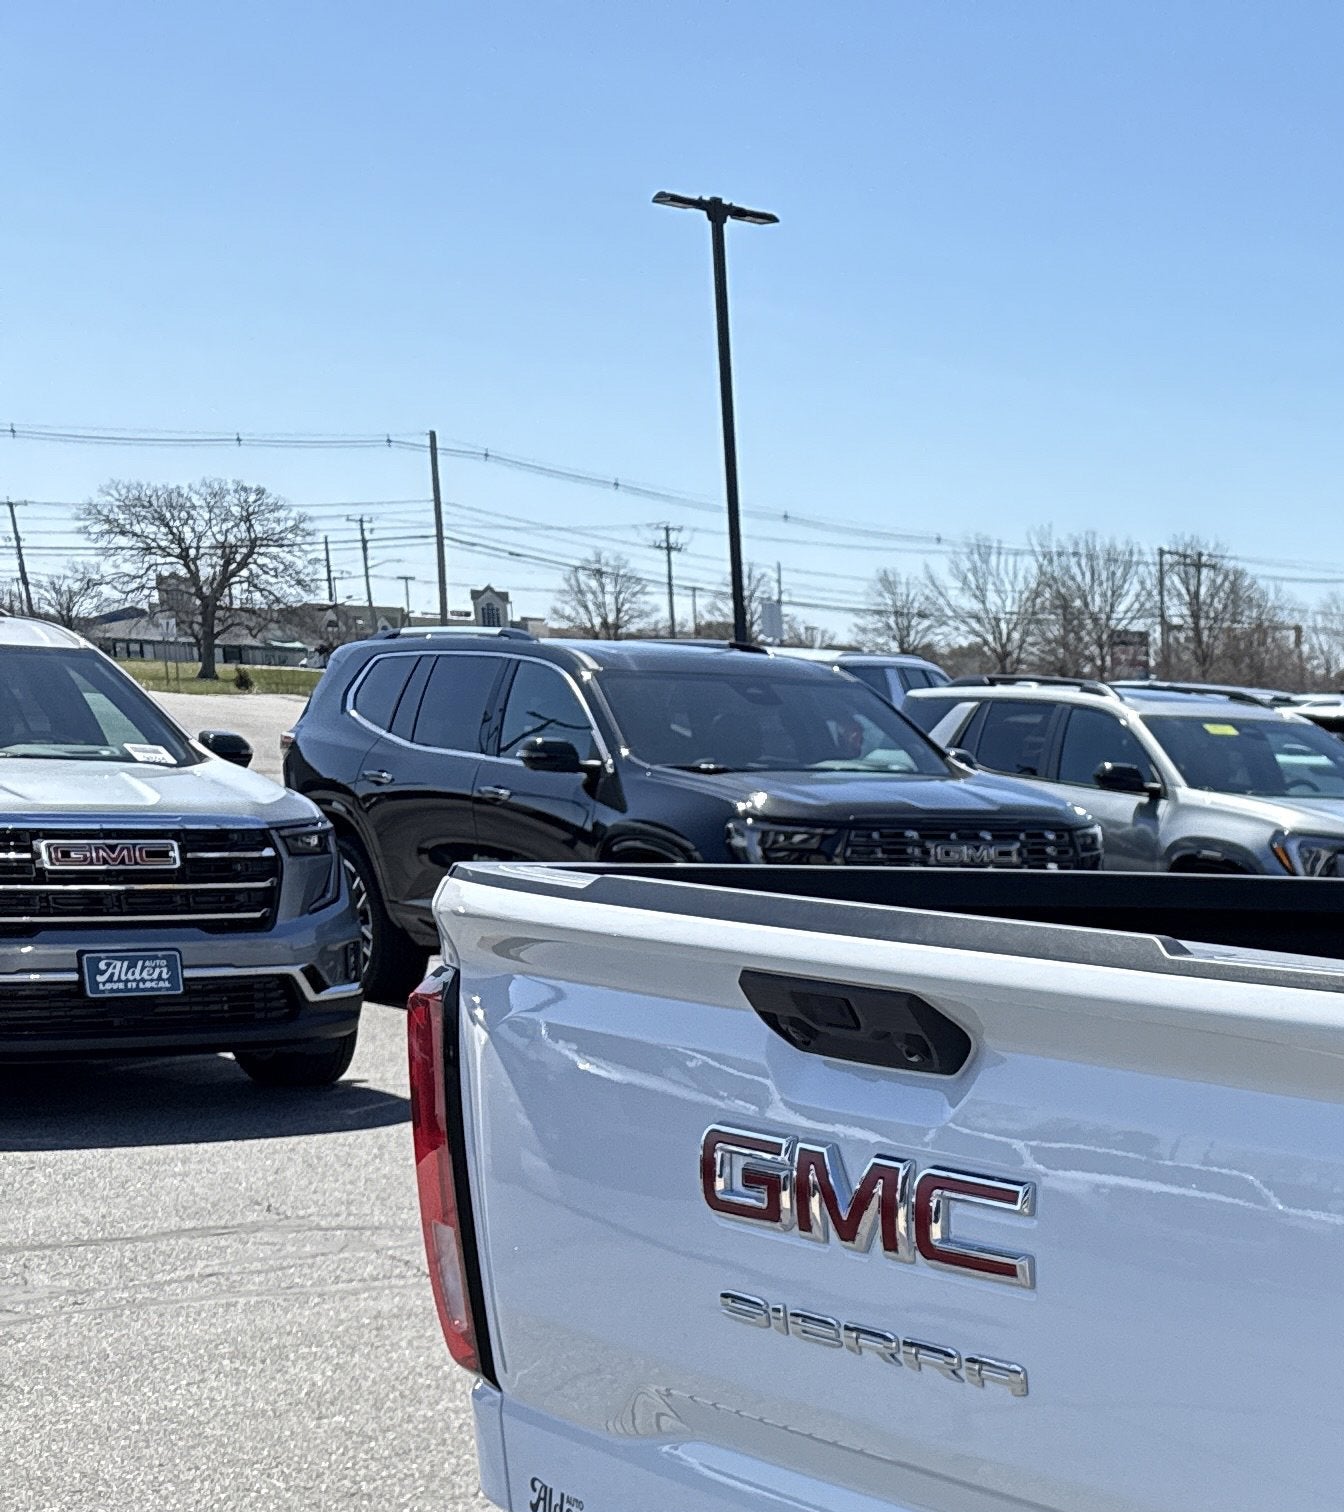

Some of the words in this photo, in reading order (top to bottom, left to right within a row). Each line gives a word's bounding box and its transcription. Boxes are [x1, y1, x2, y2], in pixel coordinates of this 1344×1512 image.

[51, 844, 174, 865] GMC
[936, 845, 1019, 863] GMC
[95, 959, 171, 983] Alden
[144, 959, 167, 968] AUTO
[99, 982, 125, 990] LOVE
[127, 981, 137, 989] IT
[139, 980, 171, 989] LOCAL
[699, 1122, 1036, 1290] GMC
[719, 1289, 1028, 1397] SIERRA
[566, 1495, 584, 1511] AUTO
